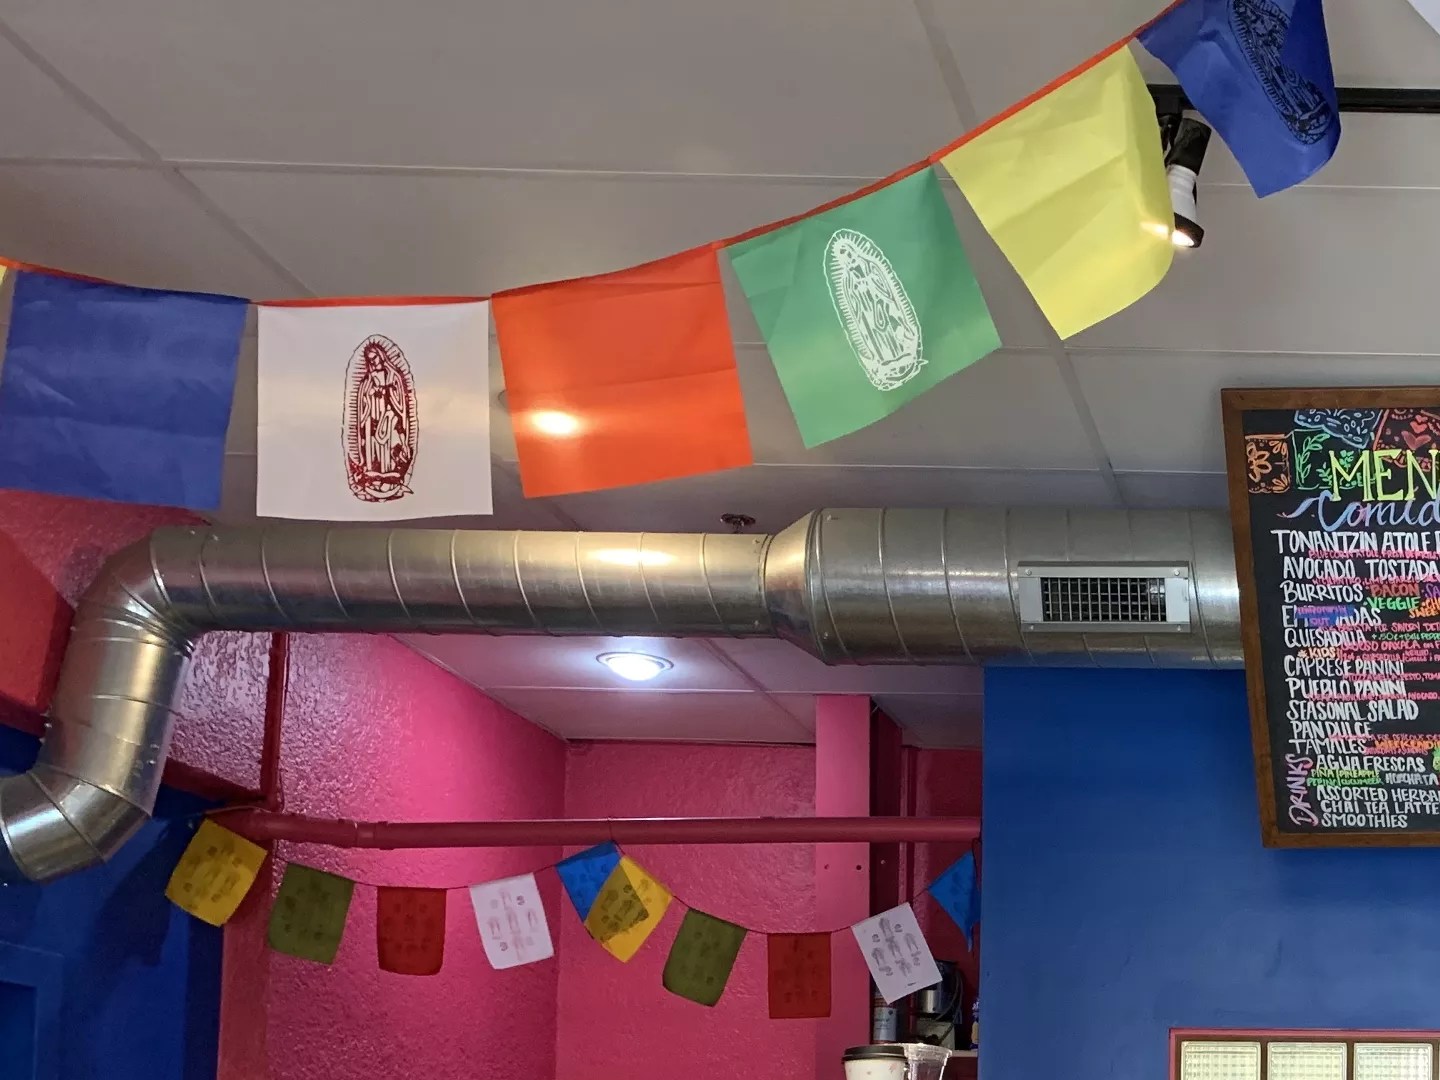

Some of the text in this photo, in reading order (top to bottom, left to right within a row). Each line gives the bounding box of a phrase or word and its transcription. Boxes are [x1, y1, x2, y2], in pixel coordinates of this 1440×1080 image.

[1271, 530, 1378, 554] TONANTZIN
[1382, 531, 1431, 555] ATOLE
[1283, 556, 1440, 582] AVOCADO TOSTADA
[1280, 580, 1364, 603] BURRITOS
[1284, 628, 1367, 649] QUESADILLA
[1284, 655, 1405, 677] CAPRESE PANINI
[1285, 678, 1350, 699] PUEBLO
[1354, 679, 1408, 699] PANINI
[1286, 699, 1419, 722] SEASONAL SALAD
[1290, 721, 1326, 741] PAN
[1326, 722, 1372, 740] DULCE
[1288, 738, 1365, 755] TAMALES
[1316, 755, 1426, 772] AGUA FRESCAS
[1285, 753, 1318, 826] DRINKS
[1317, 785, 1389, 802] ASSORTED
[1320, 800, 1440, 815] CHAI TEA LATTE
[1322, 813, 1408, 828] SMOOTHIES
